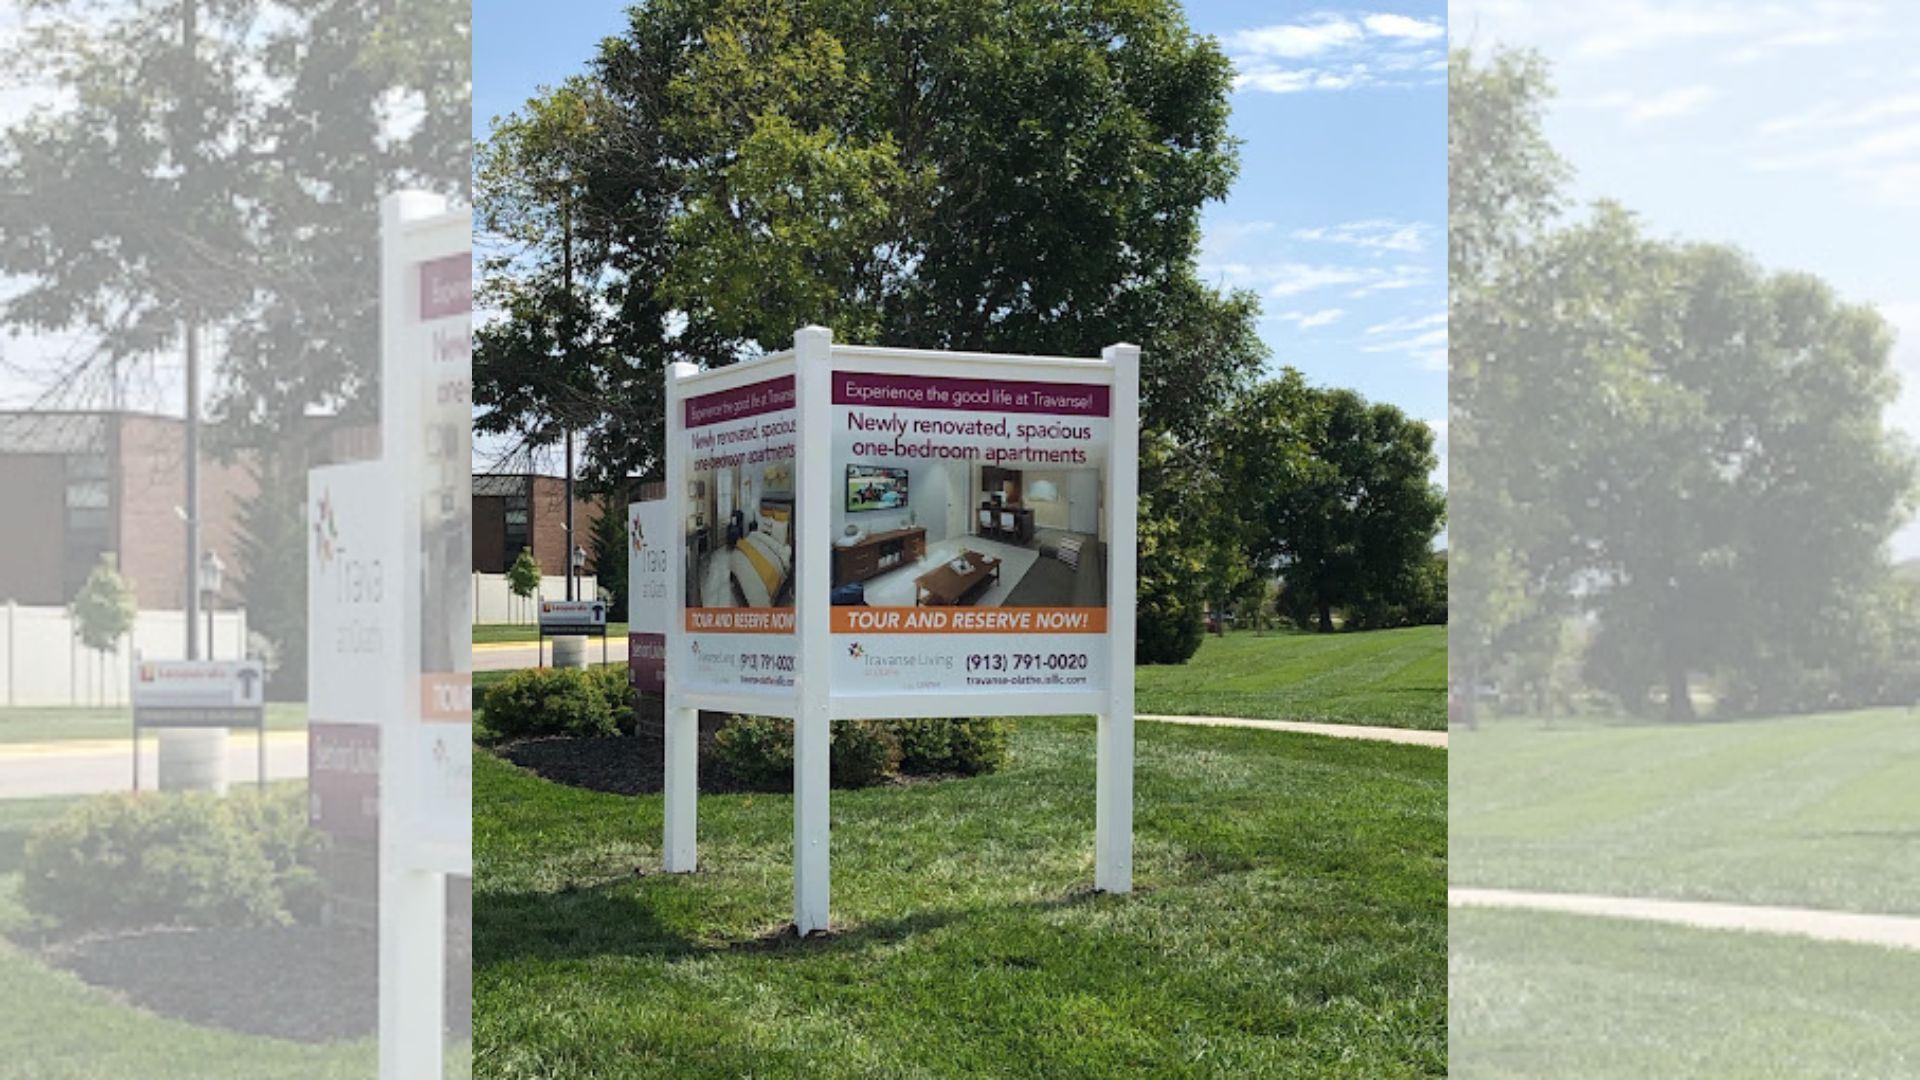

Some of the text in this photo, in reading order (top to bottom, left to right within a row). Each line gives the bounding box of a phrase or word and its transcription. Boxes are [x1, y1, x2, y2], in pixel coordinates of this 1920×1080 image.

[846, 381, 1093, 409] Experience the good life at Travanse!
[848, 412, 1092, 443] Newly renovated, spacious
[852, 438, 1087, 465] one-bedroom apartments
[848, 611, 1090, 629] TOUR AND RESERVE NOW!
[864, 654, 954, 670] Travanse Living
[966, 653, 1089, 673] (913) 791-0020
